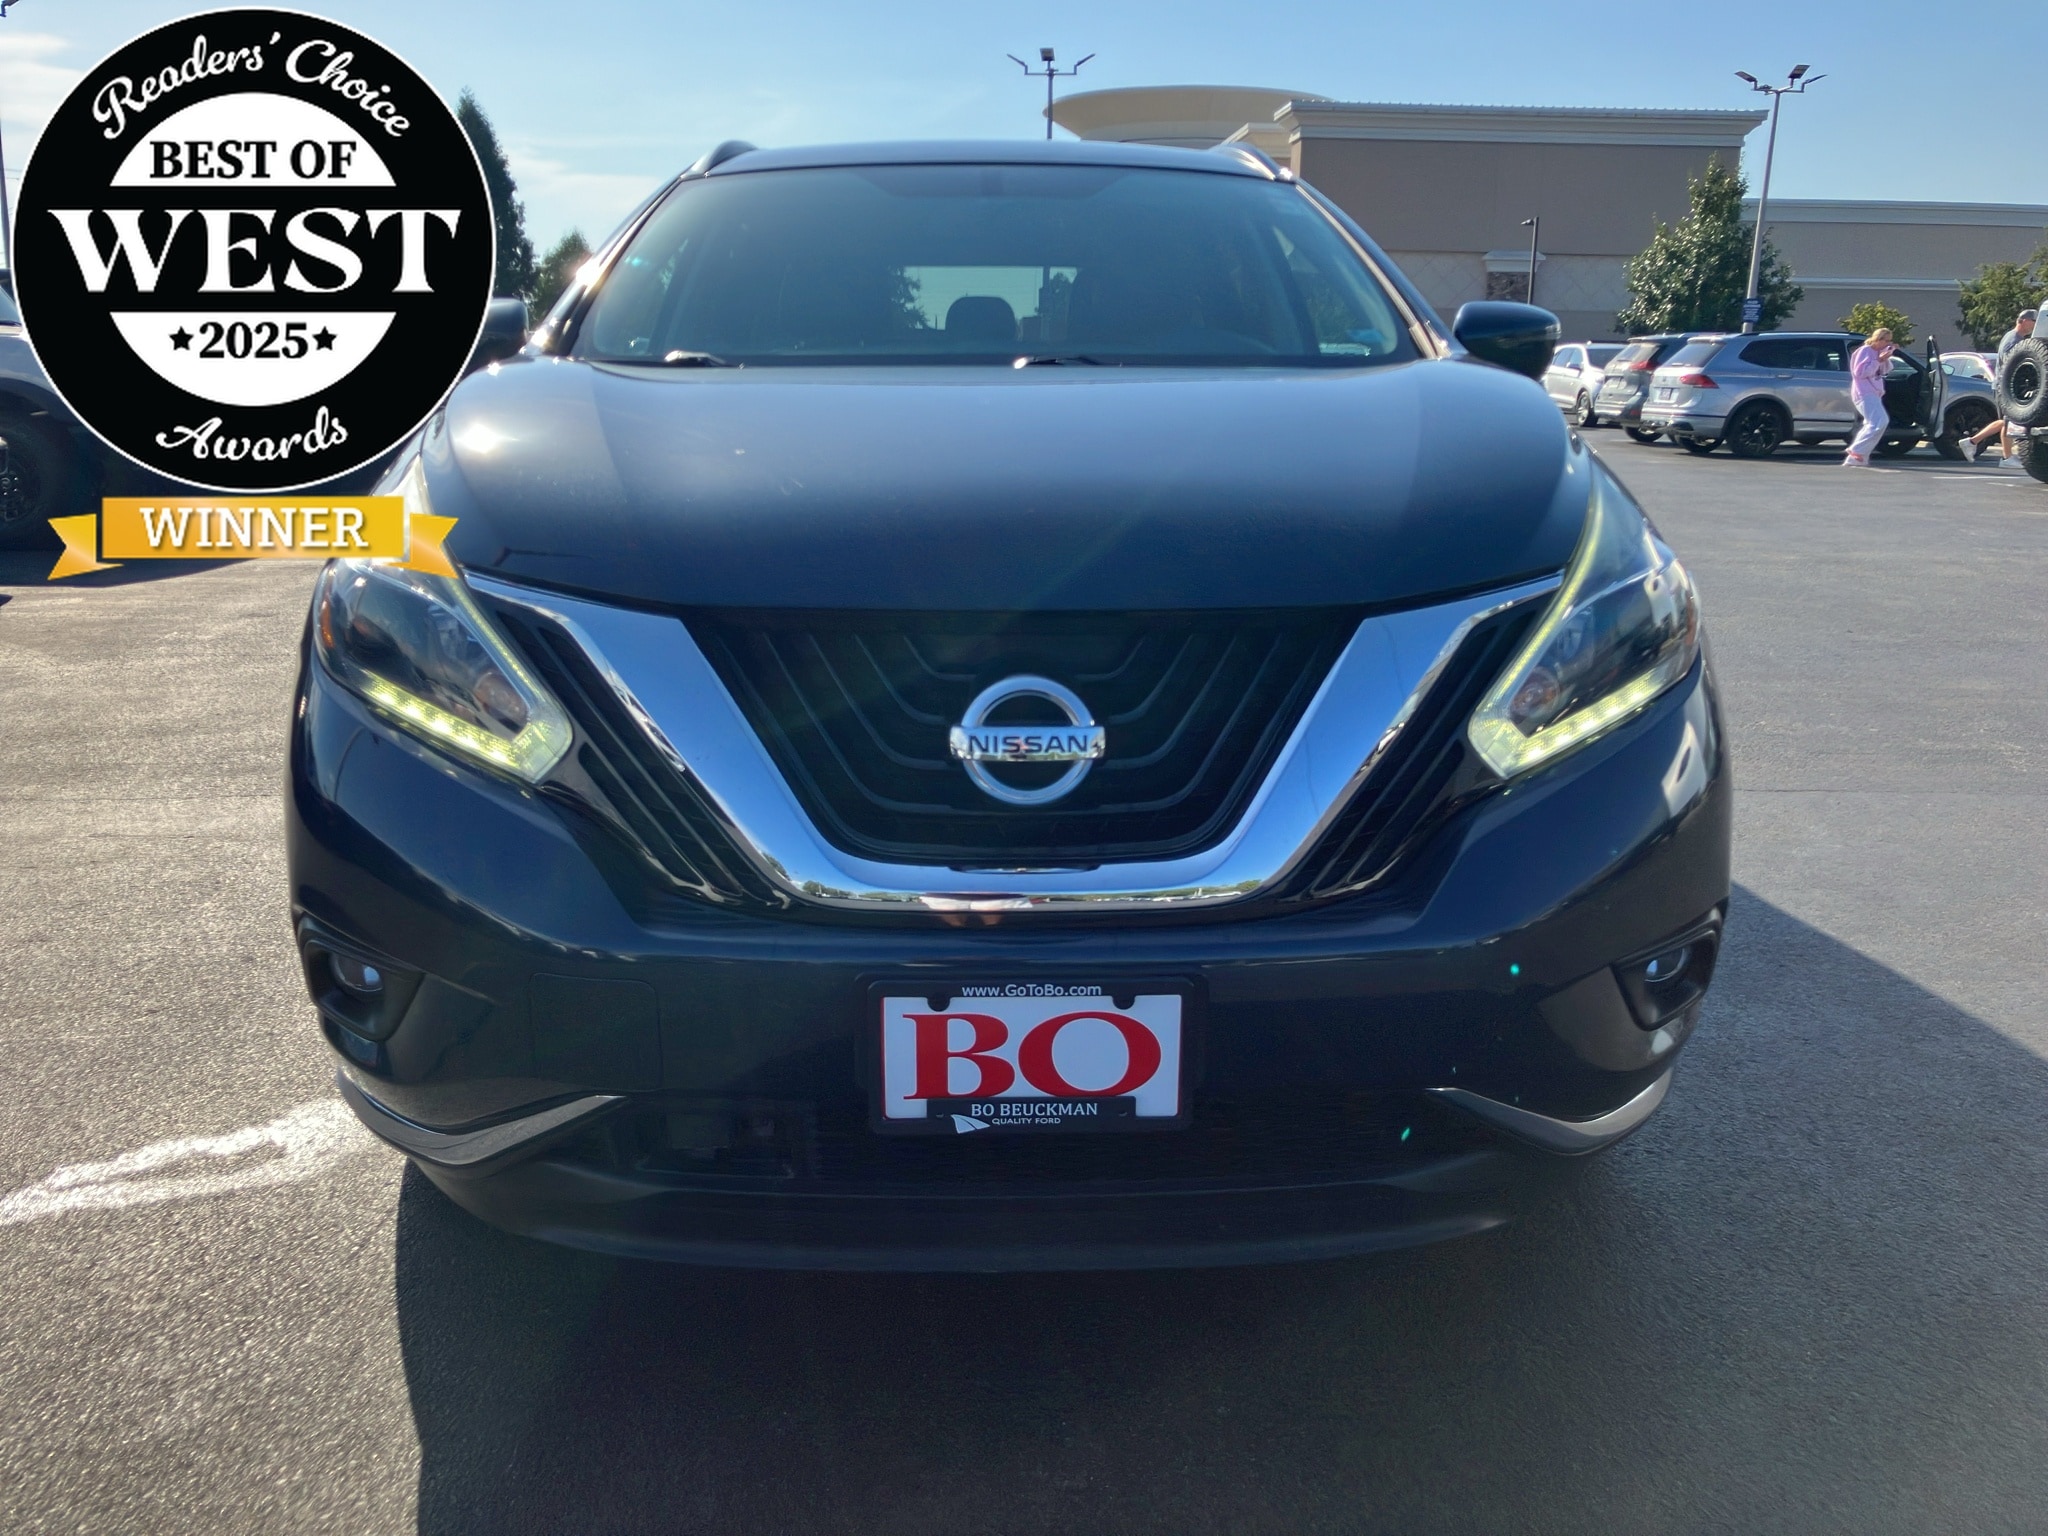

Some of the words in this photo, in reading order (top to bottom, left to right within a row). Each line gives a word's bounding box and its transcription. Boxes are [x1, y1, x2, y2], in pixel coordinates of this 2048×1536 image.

[968, 735, 1088, 753] NISSAN
[962, 984, 1102, 997] www.GoToBo.com
[902, 1011, 1162, 1100] BO
[971, 1103, 995, 1117] BO
[1000, 1102, 1098, 1117] BEUCKMAN
[991, 1117, 1032, 1125] QUALITY
[1035, 1116, 1061, 1125] FORD
